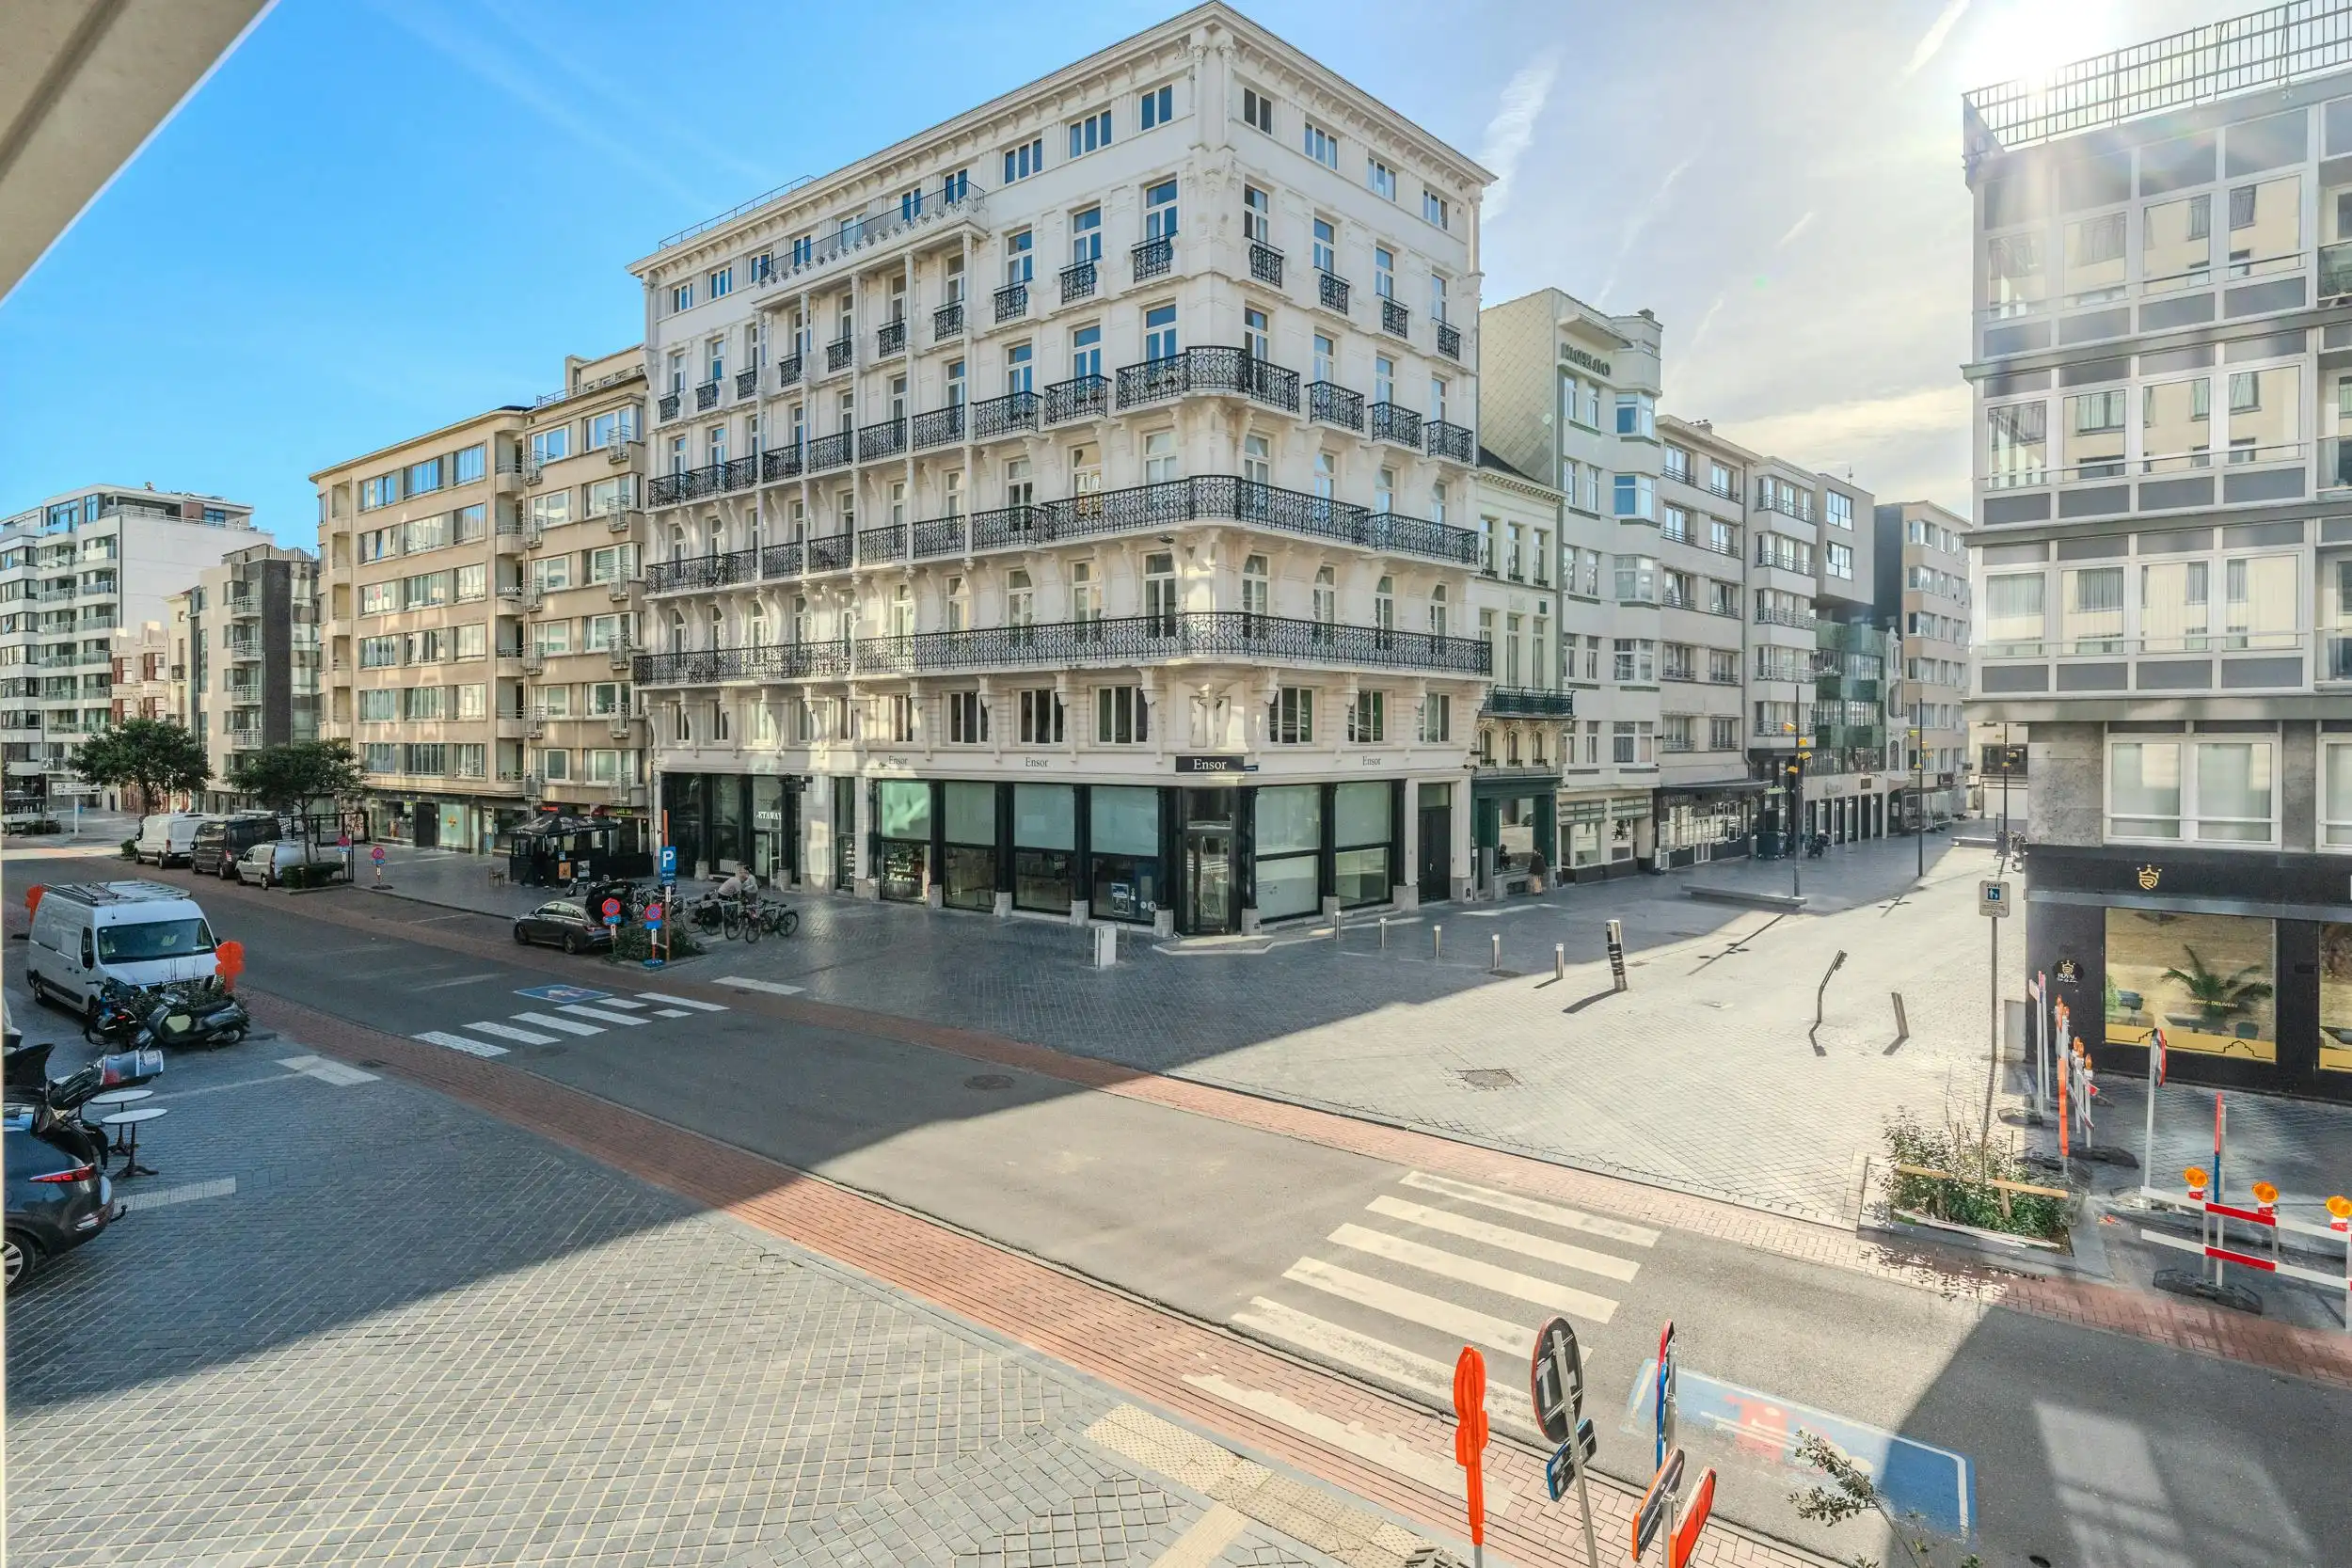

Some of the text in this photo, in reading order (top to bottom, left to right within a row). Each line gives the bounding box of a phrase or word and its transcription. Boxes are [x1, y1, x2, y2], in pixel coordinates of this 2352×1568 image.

[888, 755, 908, 766] Ensor
[1025, 756, 1049, 768] Ensor
[1192, 758, 1227, 770] Ensor
[1362, 755, 1381, 766] Ensor
[662, 850, 675, 868] P
[2211, 1000, 2239, 1008] DELIVERY
